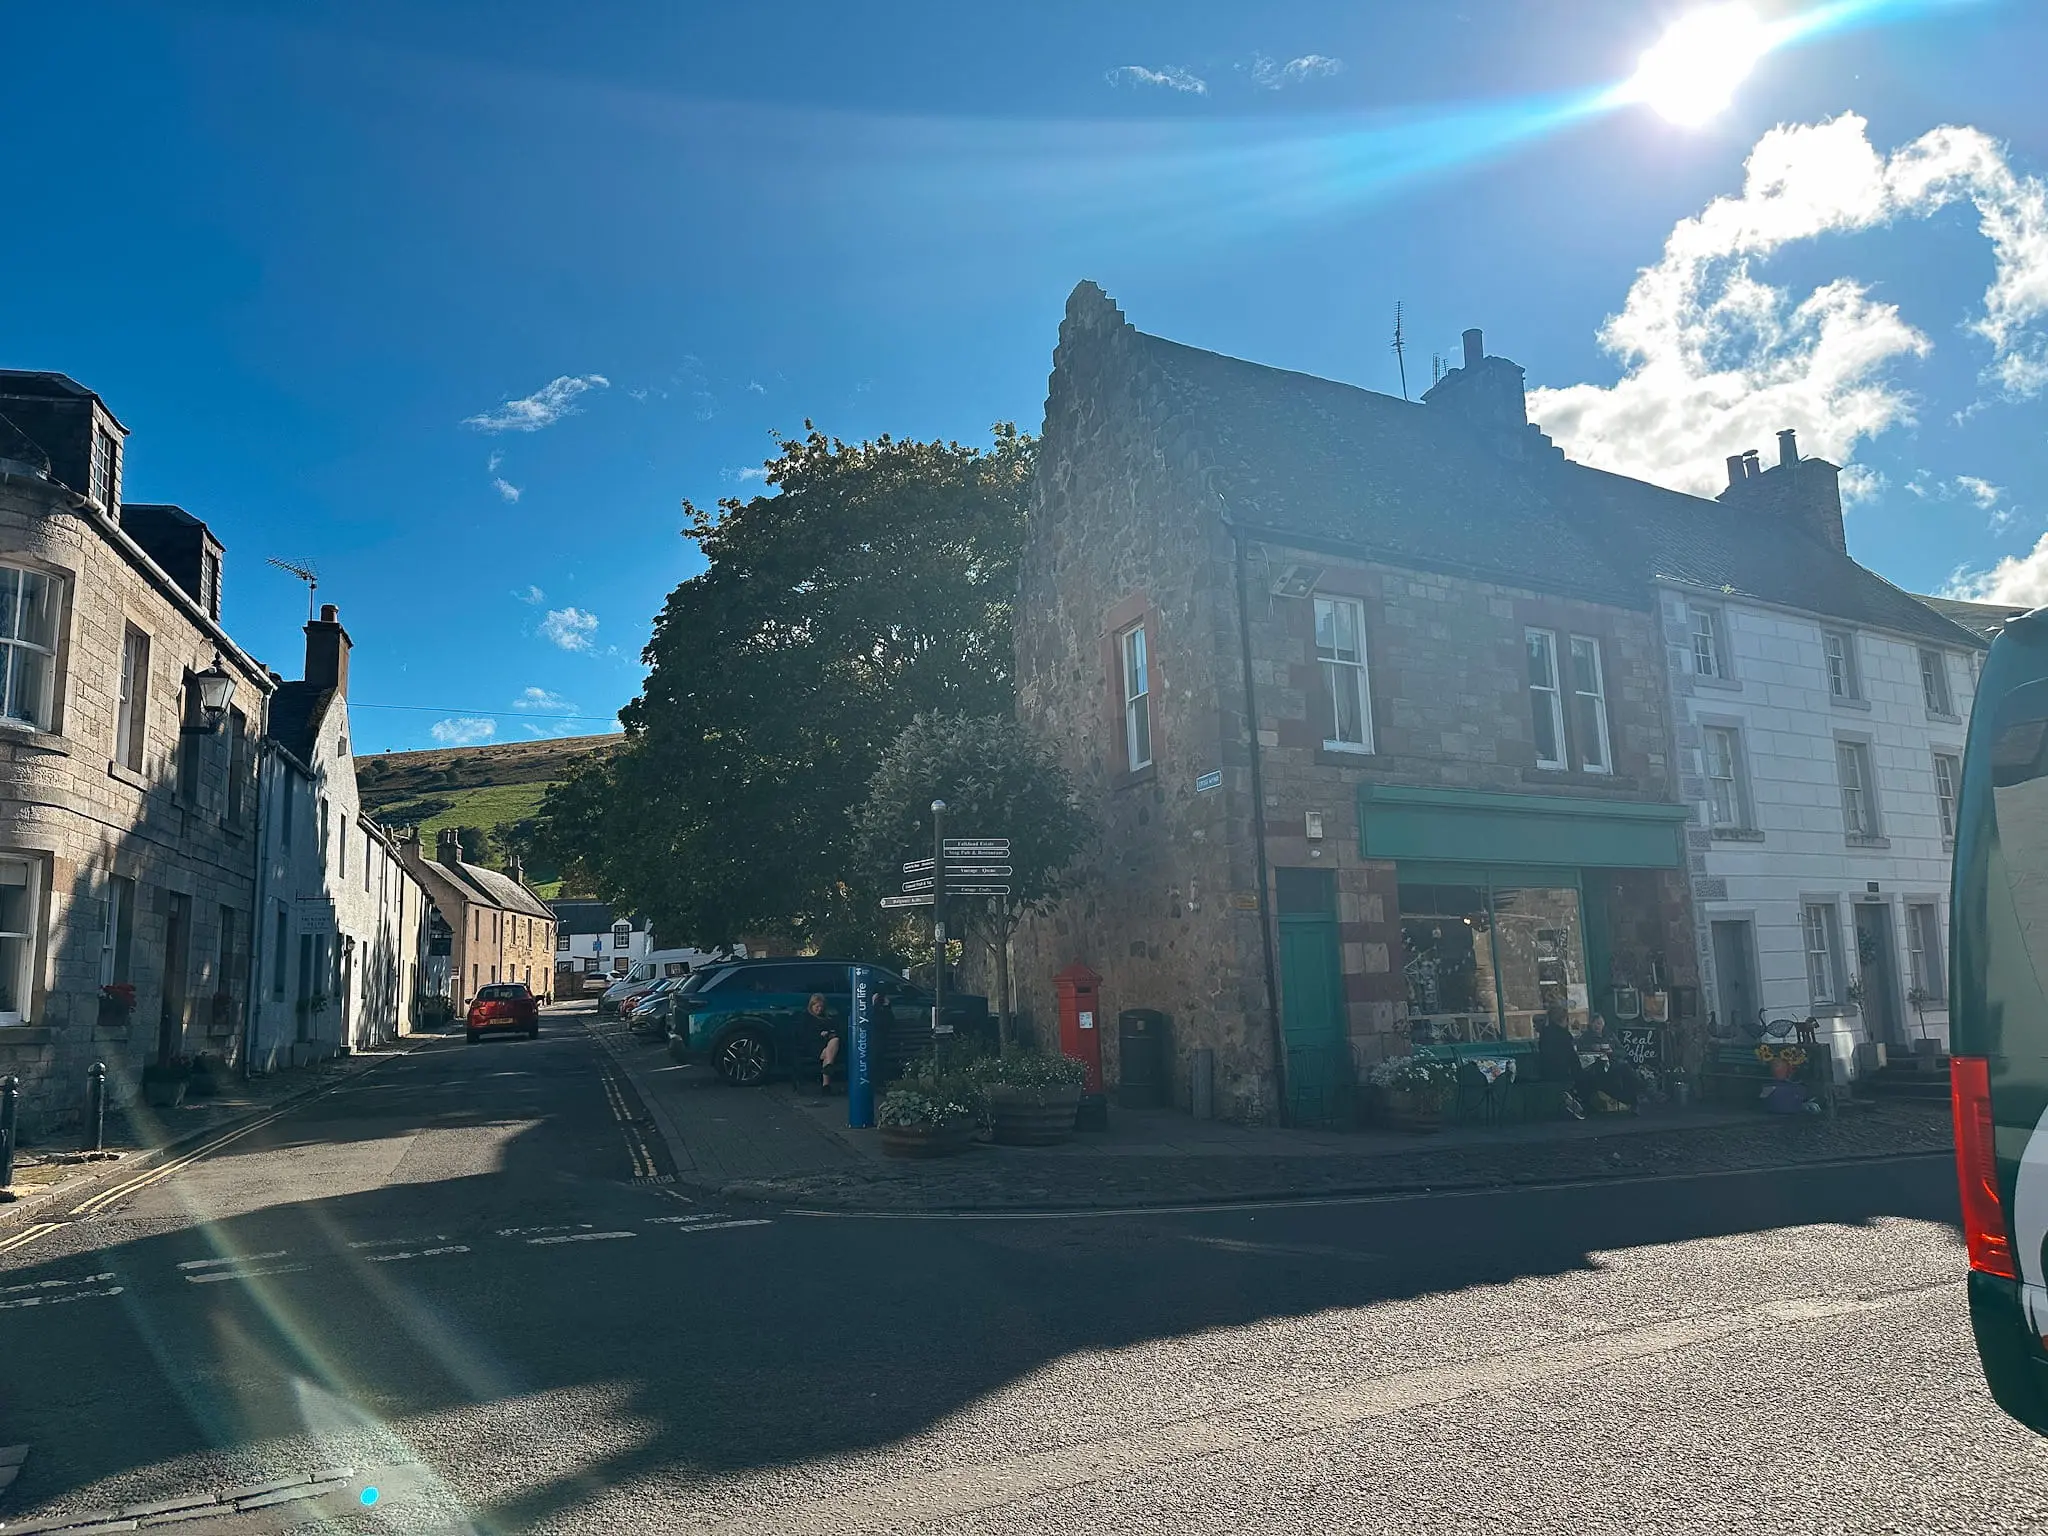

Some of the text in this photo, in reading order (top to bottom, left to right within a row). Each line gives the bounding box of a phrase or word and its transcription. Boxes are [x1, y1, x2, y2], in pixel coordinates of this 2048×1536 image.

[856, 982, 867, 998] life
[857, 1027, 867, 1059] water
[1623, 1030, 1654, 1045] Real
[859, 1060, 870, 1085] yur
